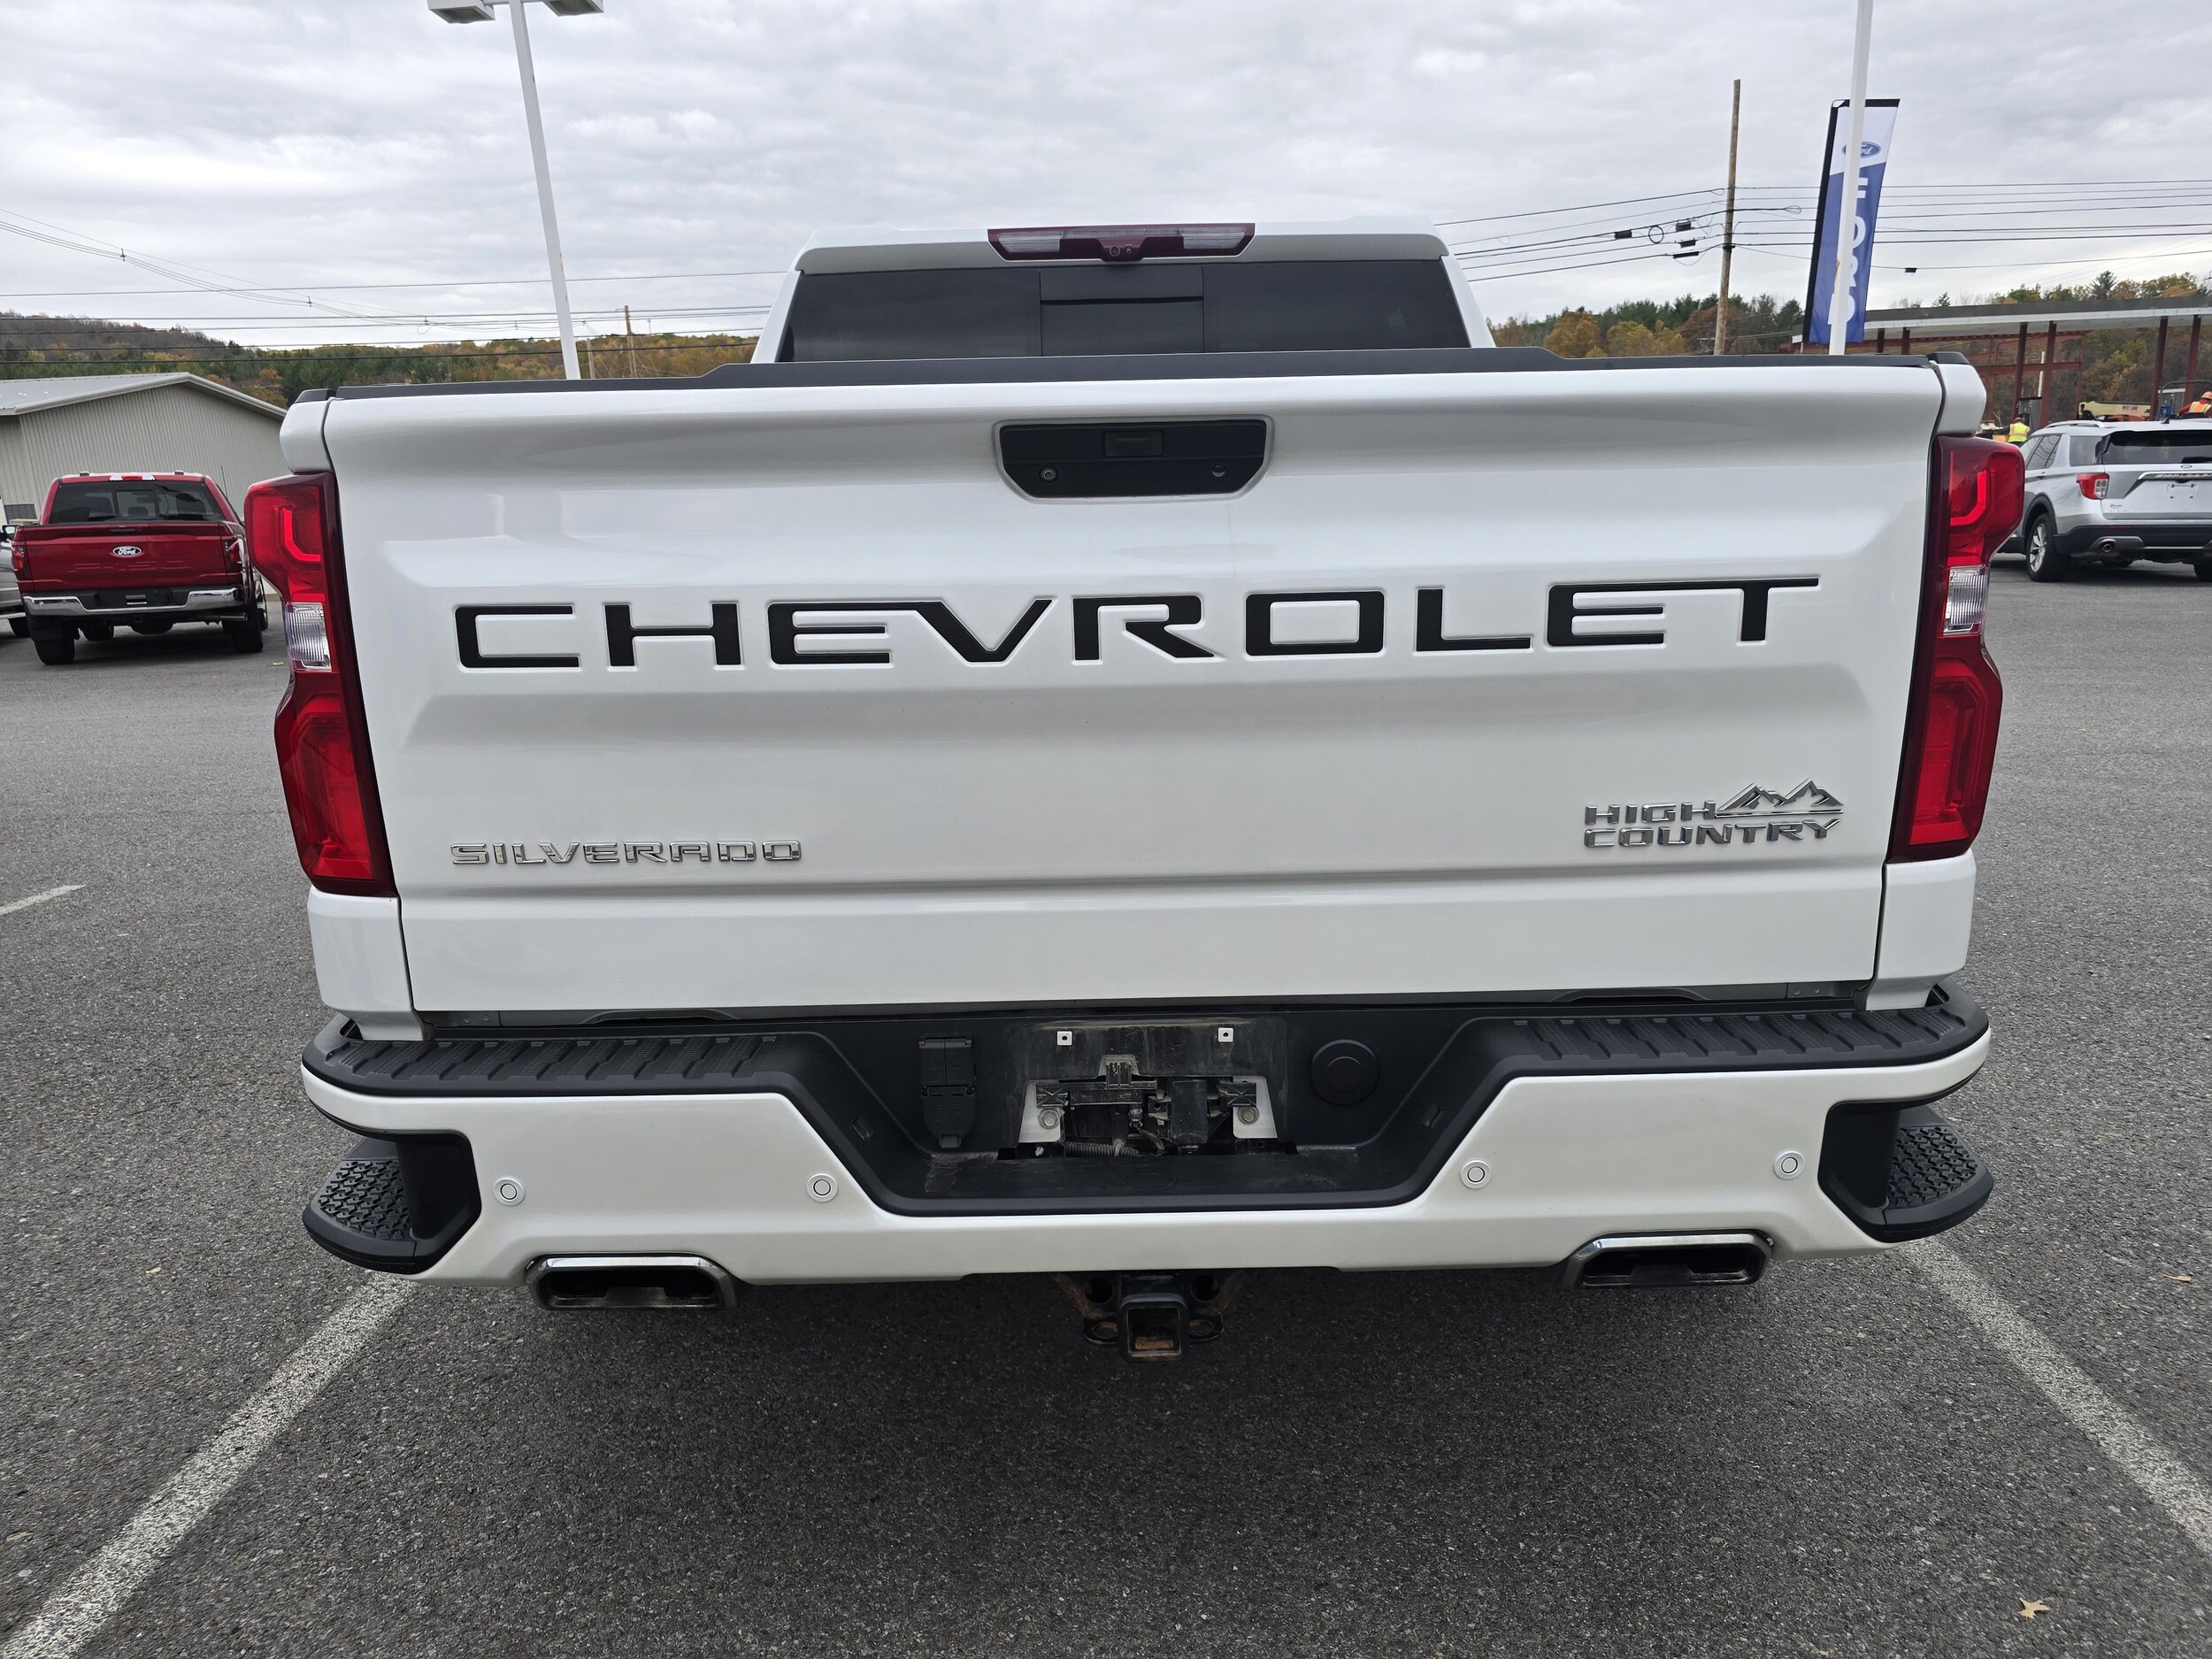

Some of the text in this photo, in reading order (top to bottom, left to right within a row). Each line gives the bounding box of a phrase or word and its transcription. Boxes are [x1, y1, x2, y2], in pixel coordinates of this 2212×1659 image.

[116, 546, 137, 557] Ford
[454, 577, 1819, 669] CHEVROLET
[1585, 800, 1717, 825] HIGH
[1584, 818, 1841, 847] COUNTRY
[450, 841, 802, 865] SILVERADO
